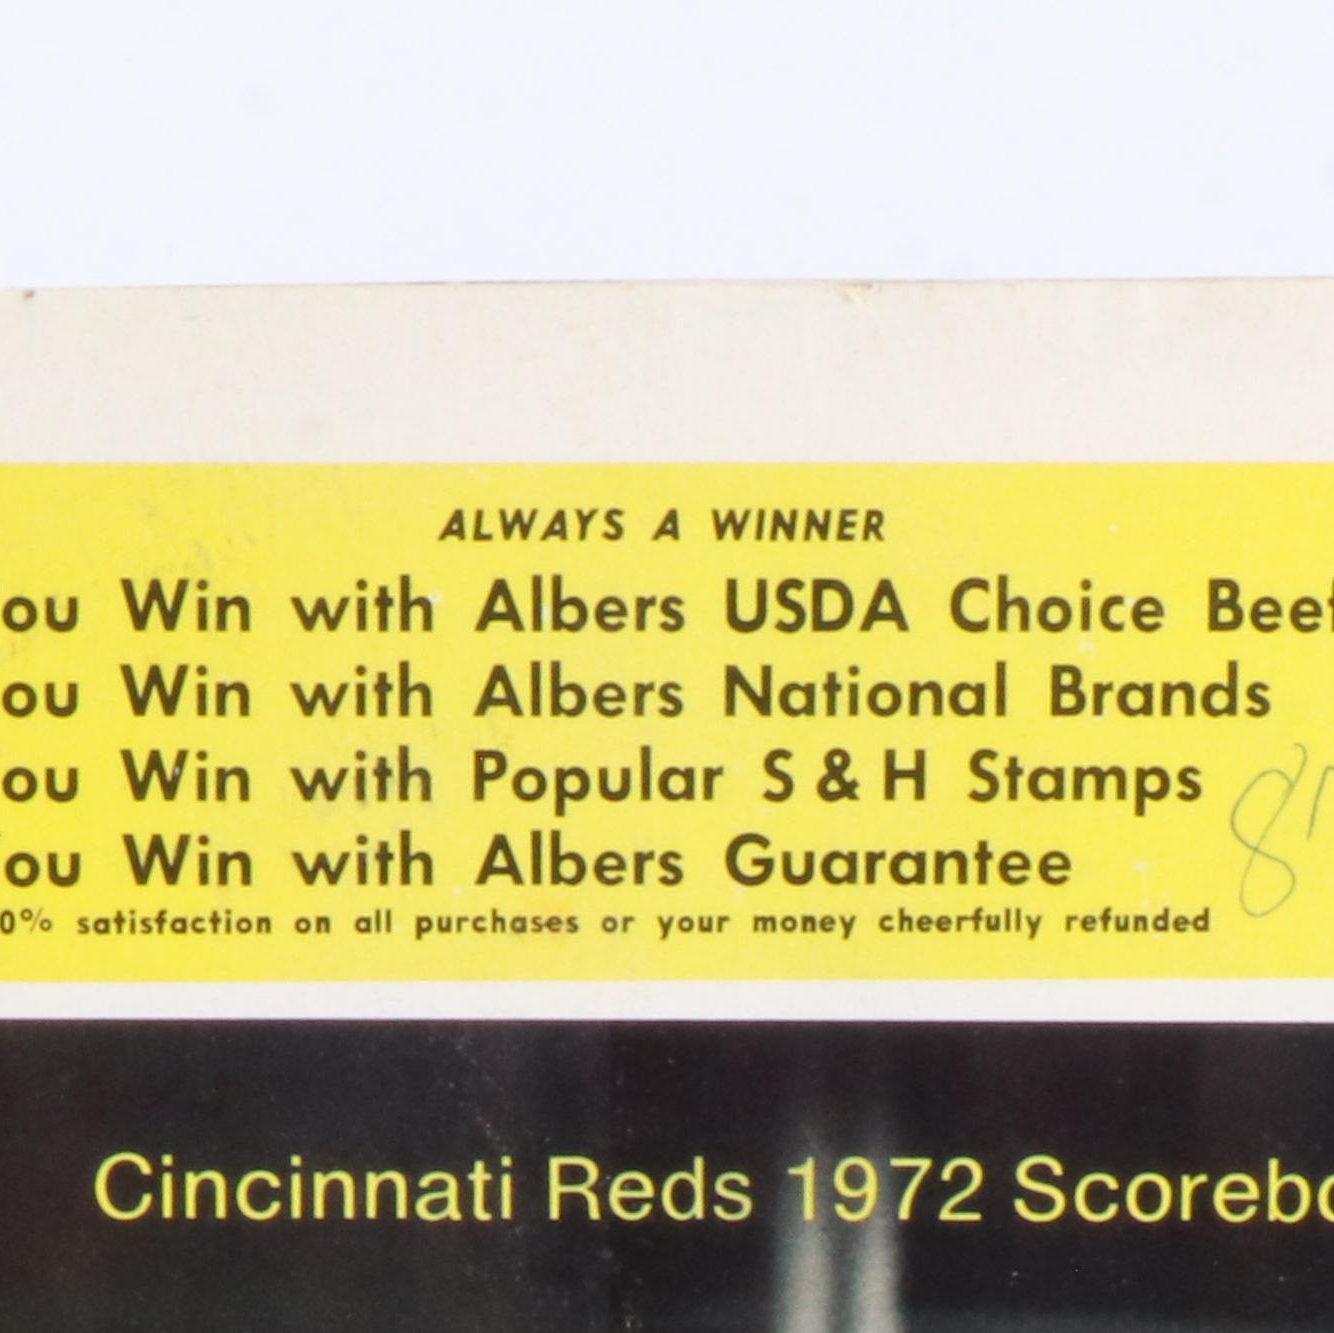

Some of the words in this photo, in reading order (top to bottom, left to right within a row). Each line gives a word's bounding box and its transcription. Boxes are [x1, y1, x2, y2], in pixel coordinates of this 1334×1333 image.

[438, 508, 625, 542] ALWAYS
[652, 509, 681, 541] A
[711, 509, 886, 542] WINNER
[120, 577, 252, 632] Win
[290, 573, 434, 632] with
[474, 573, 686, 633] Albers
[725, 577, 910, 634] USDA
[949, 573, 1165, 633] Choice
[119, 663, 251, 717] Win
[290, 659, 433, 717] with
[473, 659, 684, 718] Albers
[724, 660, 1007, 717] National
[1050, 659, 1272, 718] Brands
[119, 748, 251, 802] Win
[289, 744, 433, 802] with
[473, 744, 725, 818] Popular
[762, 747, 795, 803] S
[816, 747, 860, 803] &
[883, 748, 927, 801] H
[968, 747, 1203, 818] Stamps
[122, 833, 253, 886] Win
[291, 828, 434, 886] with
[475, 828, 685, 887] Albers
[724, 831, 1072, 887] Guarantee
[77, 908, 272, 935] satisfaction
[294, 915, 332, 935] on
[354, 908, 392, 935] all
[415, 908, 580, 940] purchases
[601, 915, 635, 934] or
[657, 915, 731, 940] your
[752, 914, 857, 940] money
[878, 906, 1042, 940] cheerfully
[1065, 906, 1210, 934] refunded
[93, 1150, 513, 1222] Cincinnati
[547, 1156, 753, 1222] Reds
[787, 1156, 984, 1223] 1972
